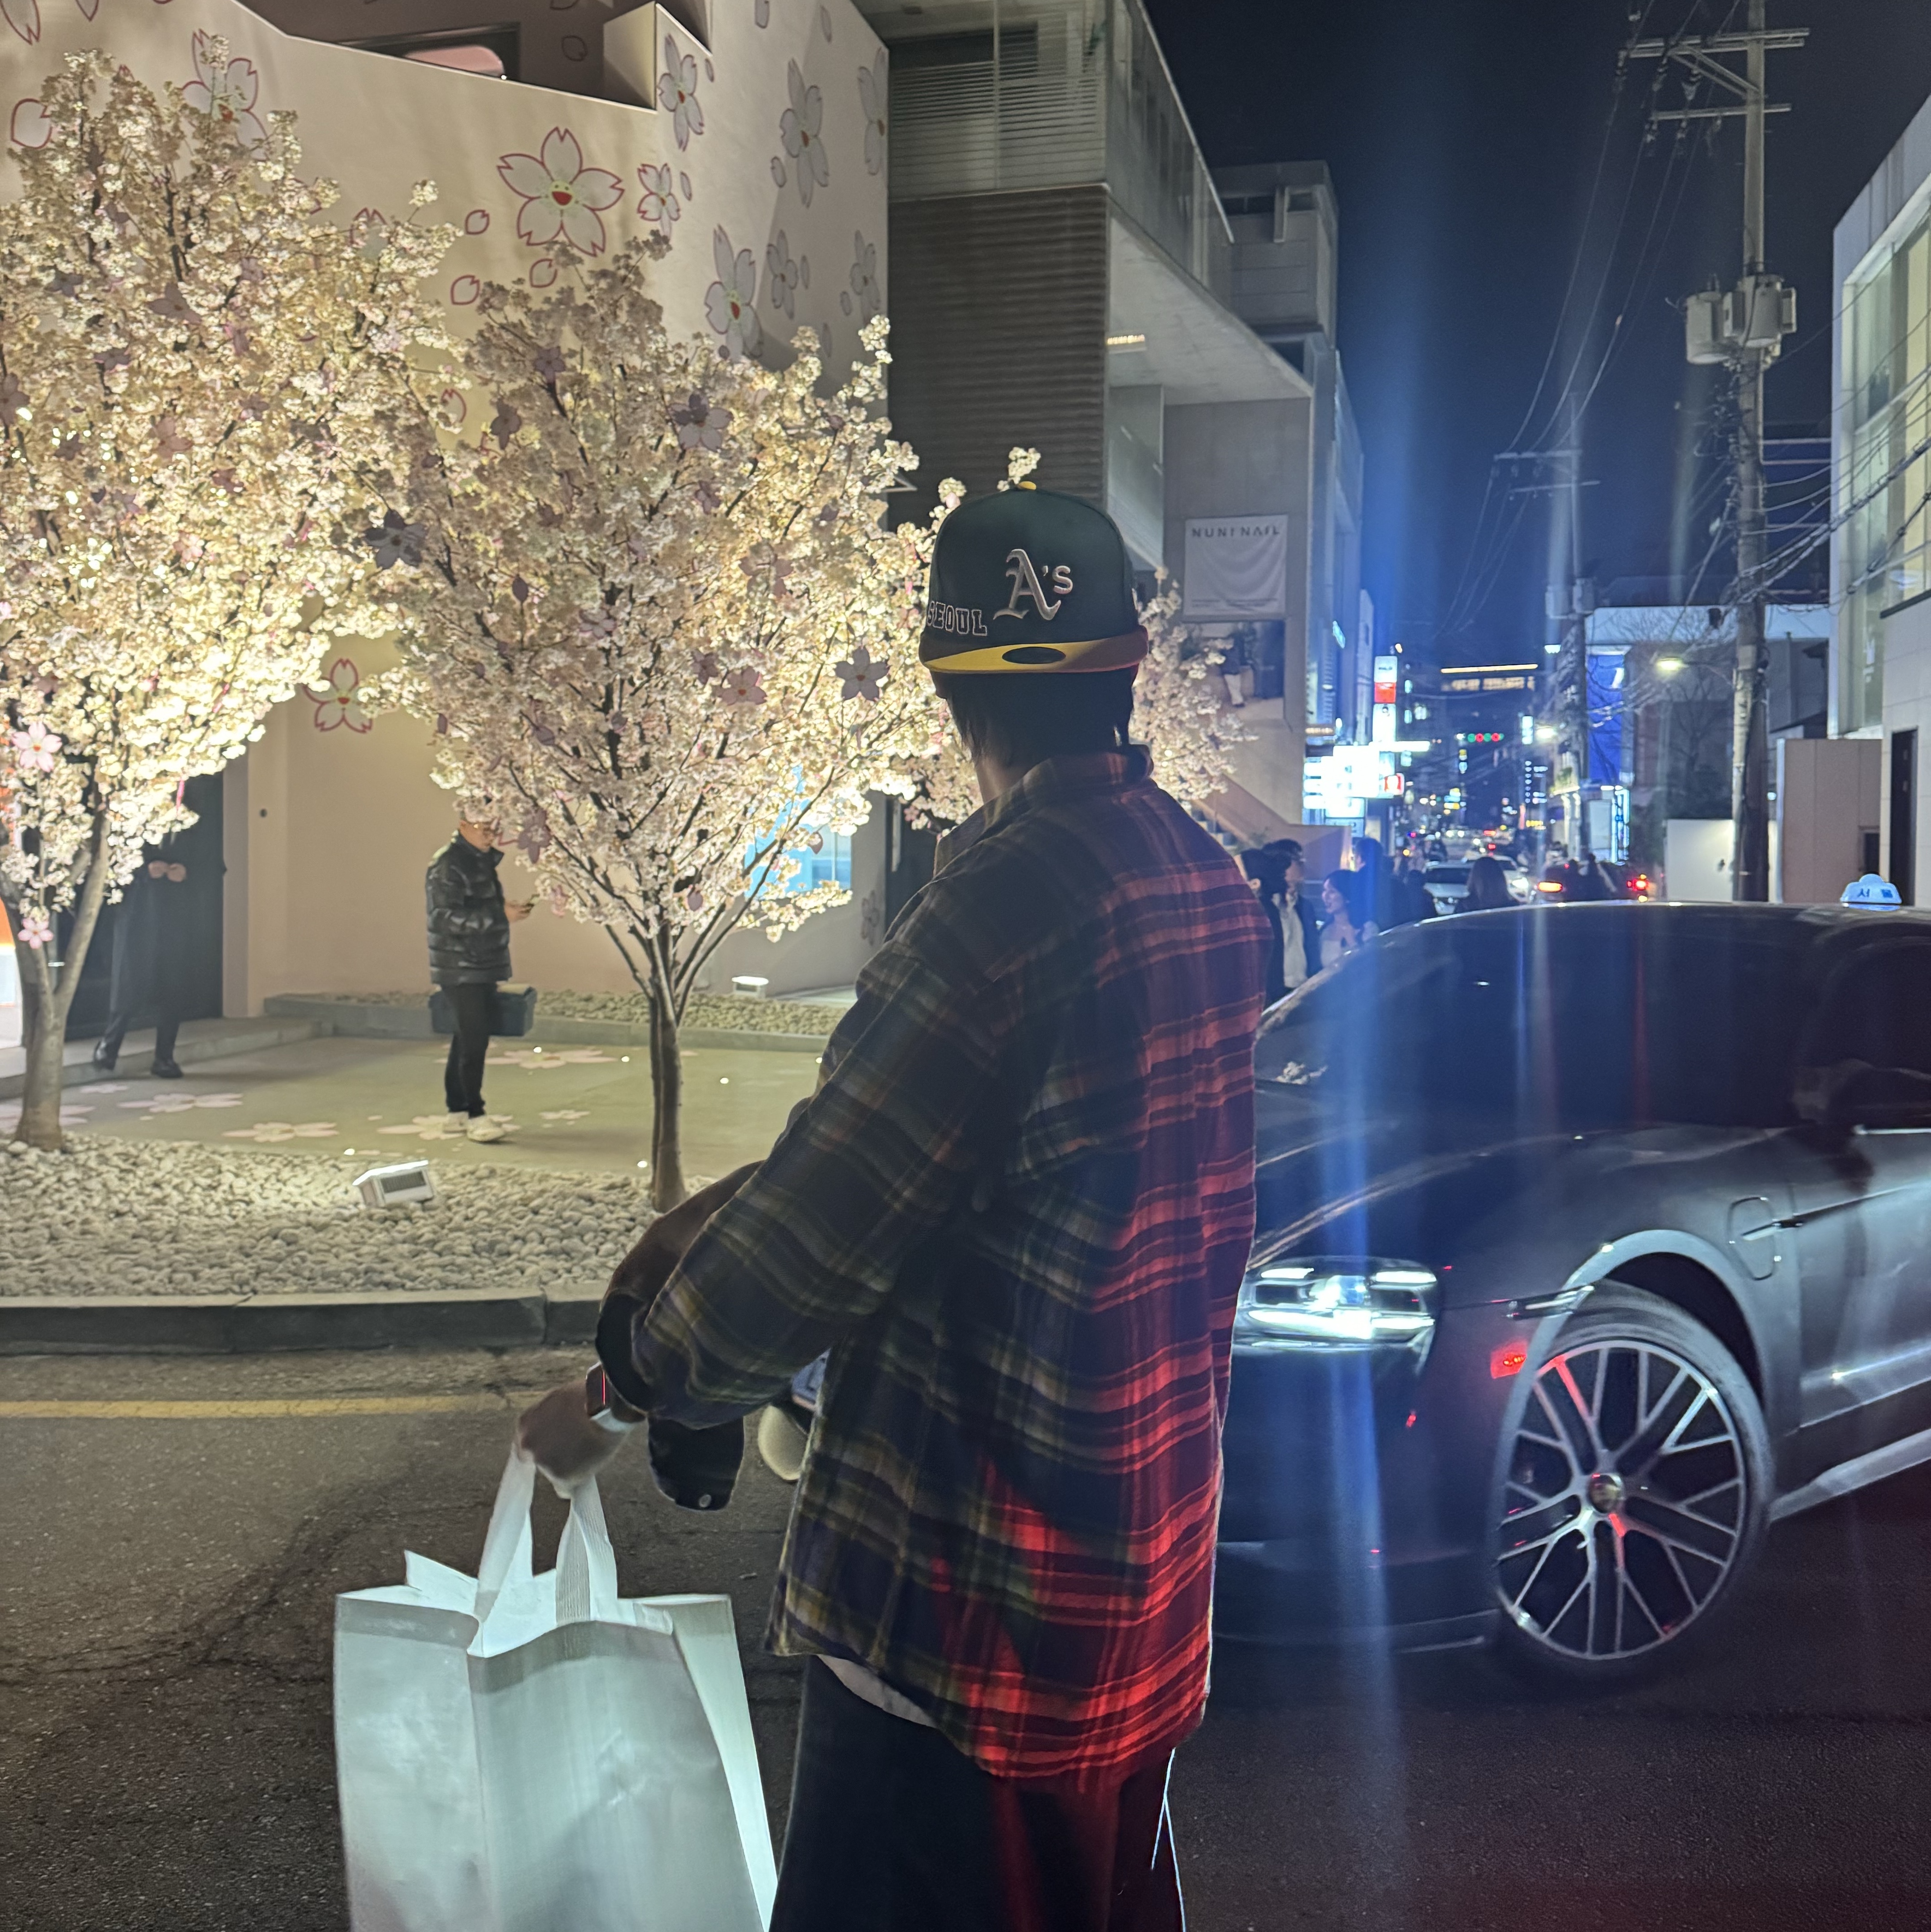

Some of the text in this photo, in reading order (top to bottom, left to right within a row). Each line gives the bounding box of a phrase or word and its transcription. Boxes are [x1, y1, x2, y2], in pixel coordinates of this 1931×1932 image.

[1192, 525, 1280, 538] NUNI NAIL
[993, 548, 1073, 620] A's
[927, 601, 987, 637] SEOUL
